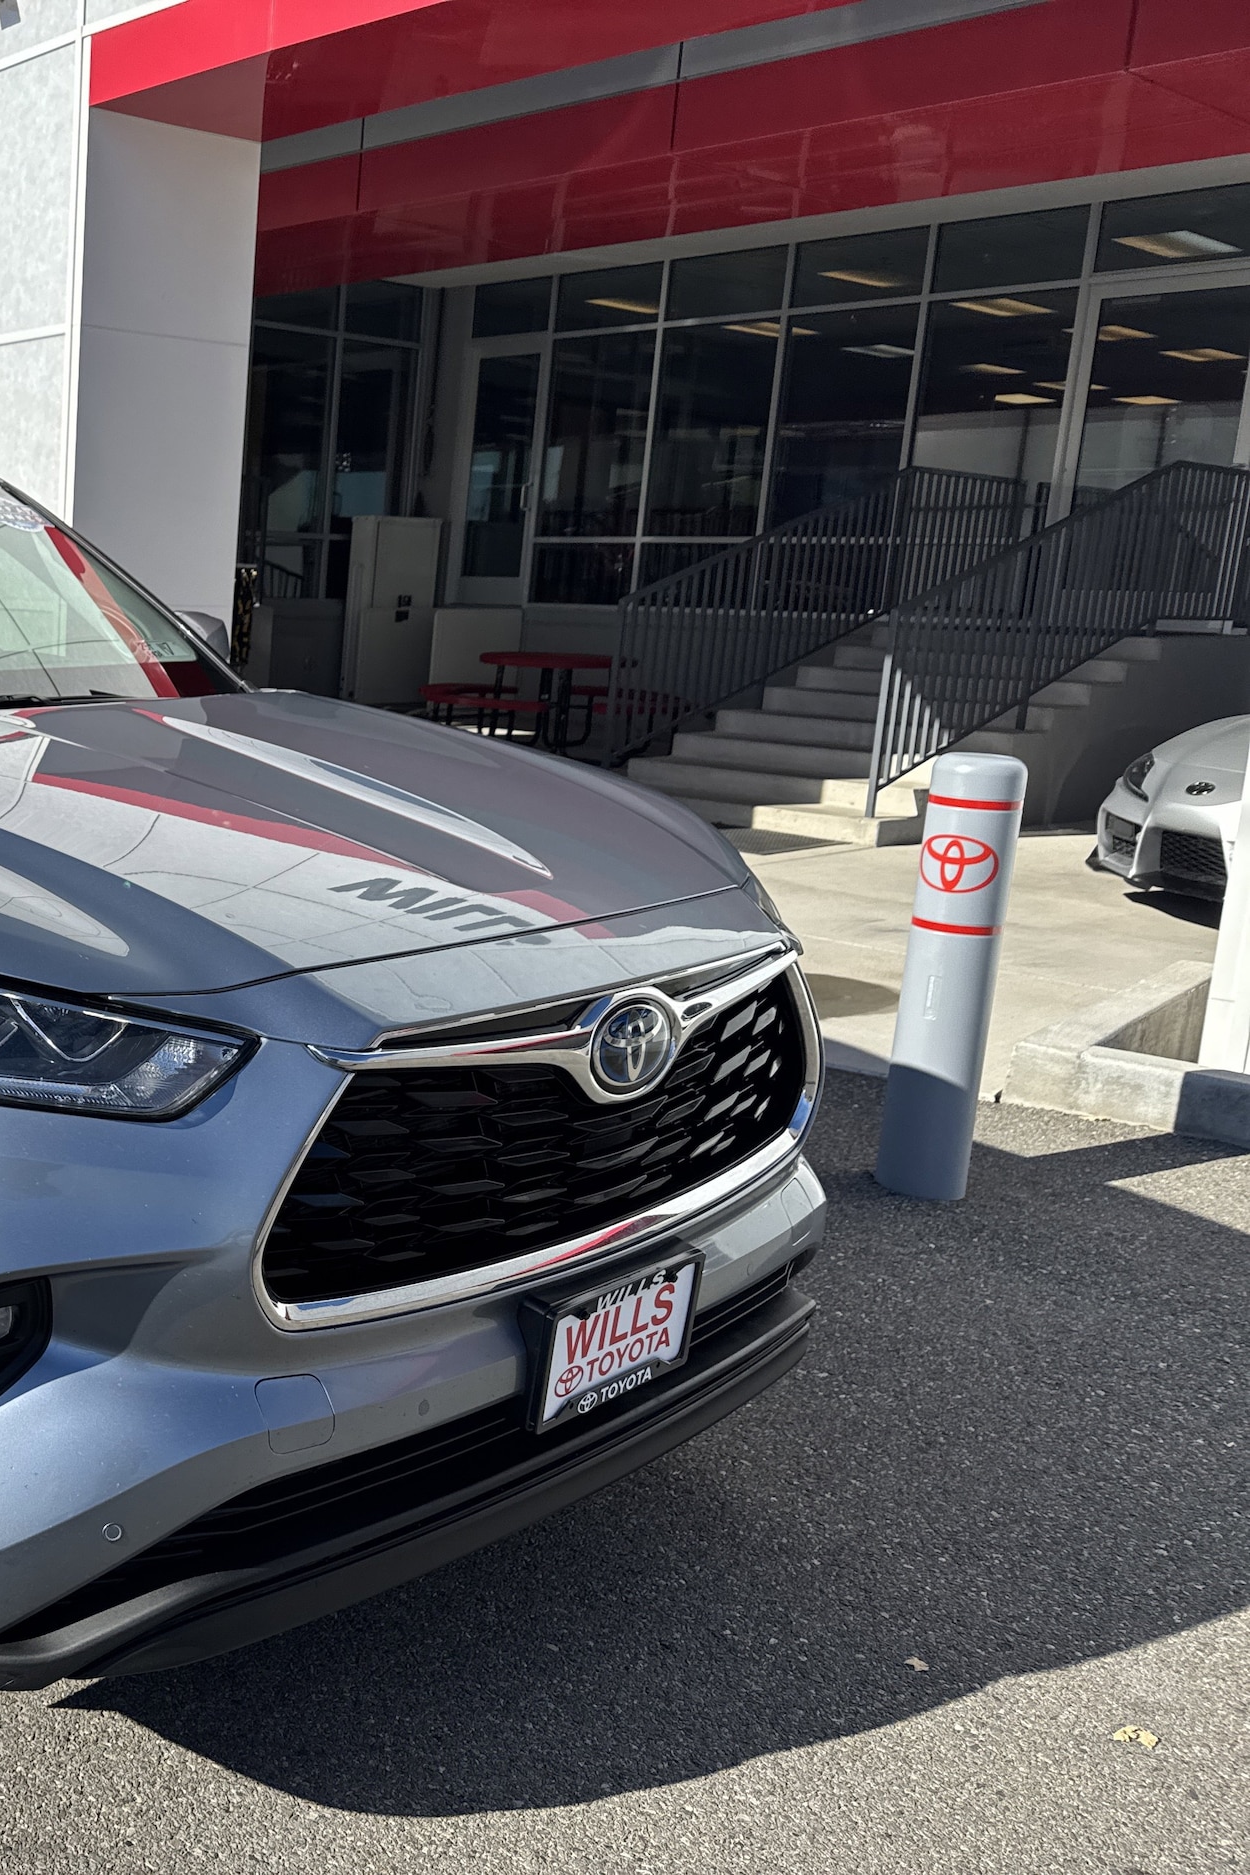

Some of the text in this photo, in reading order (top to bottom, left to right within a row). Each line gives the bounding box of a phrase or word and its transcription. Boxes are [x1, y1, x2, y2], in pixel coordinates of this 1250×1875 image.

[566, 1282, 675, 1365] WILLS
[586, 1326, 671, 1383] TOYOTA
[600, 1366, 653, 1403] TOYOTA
